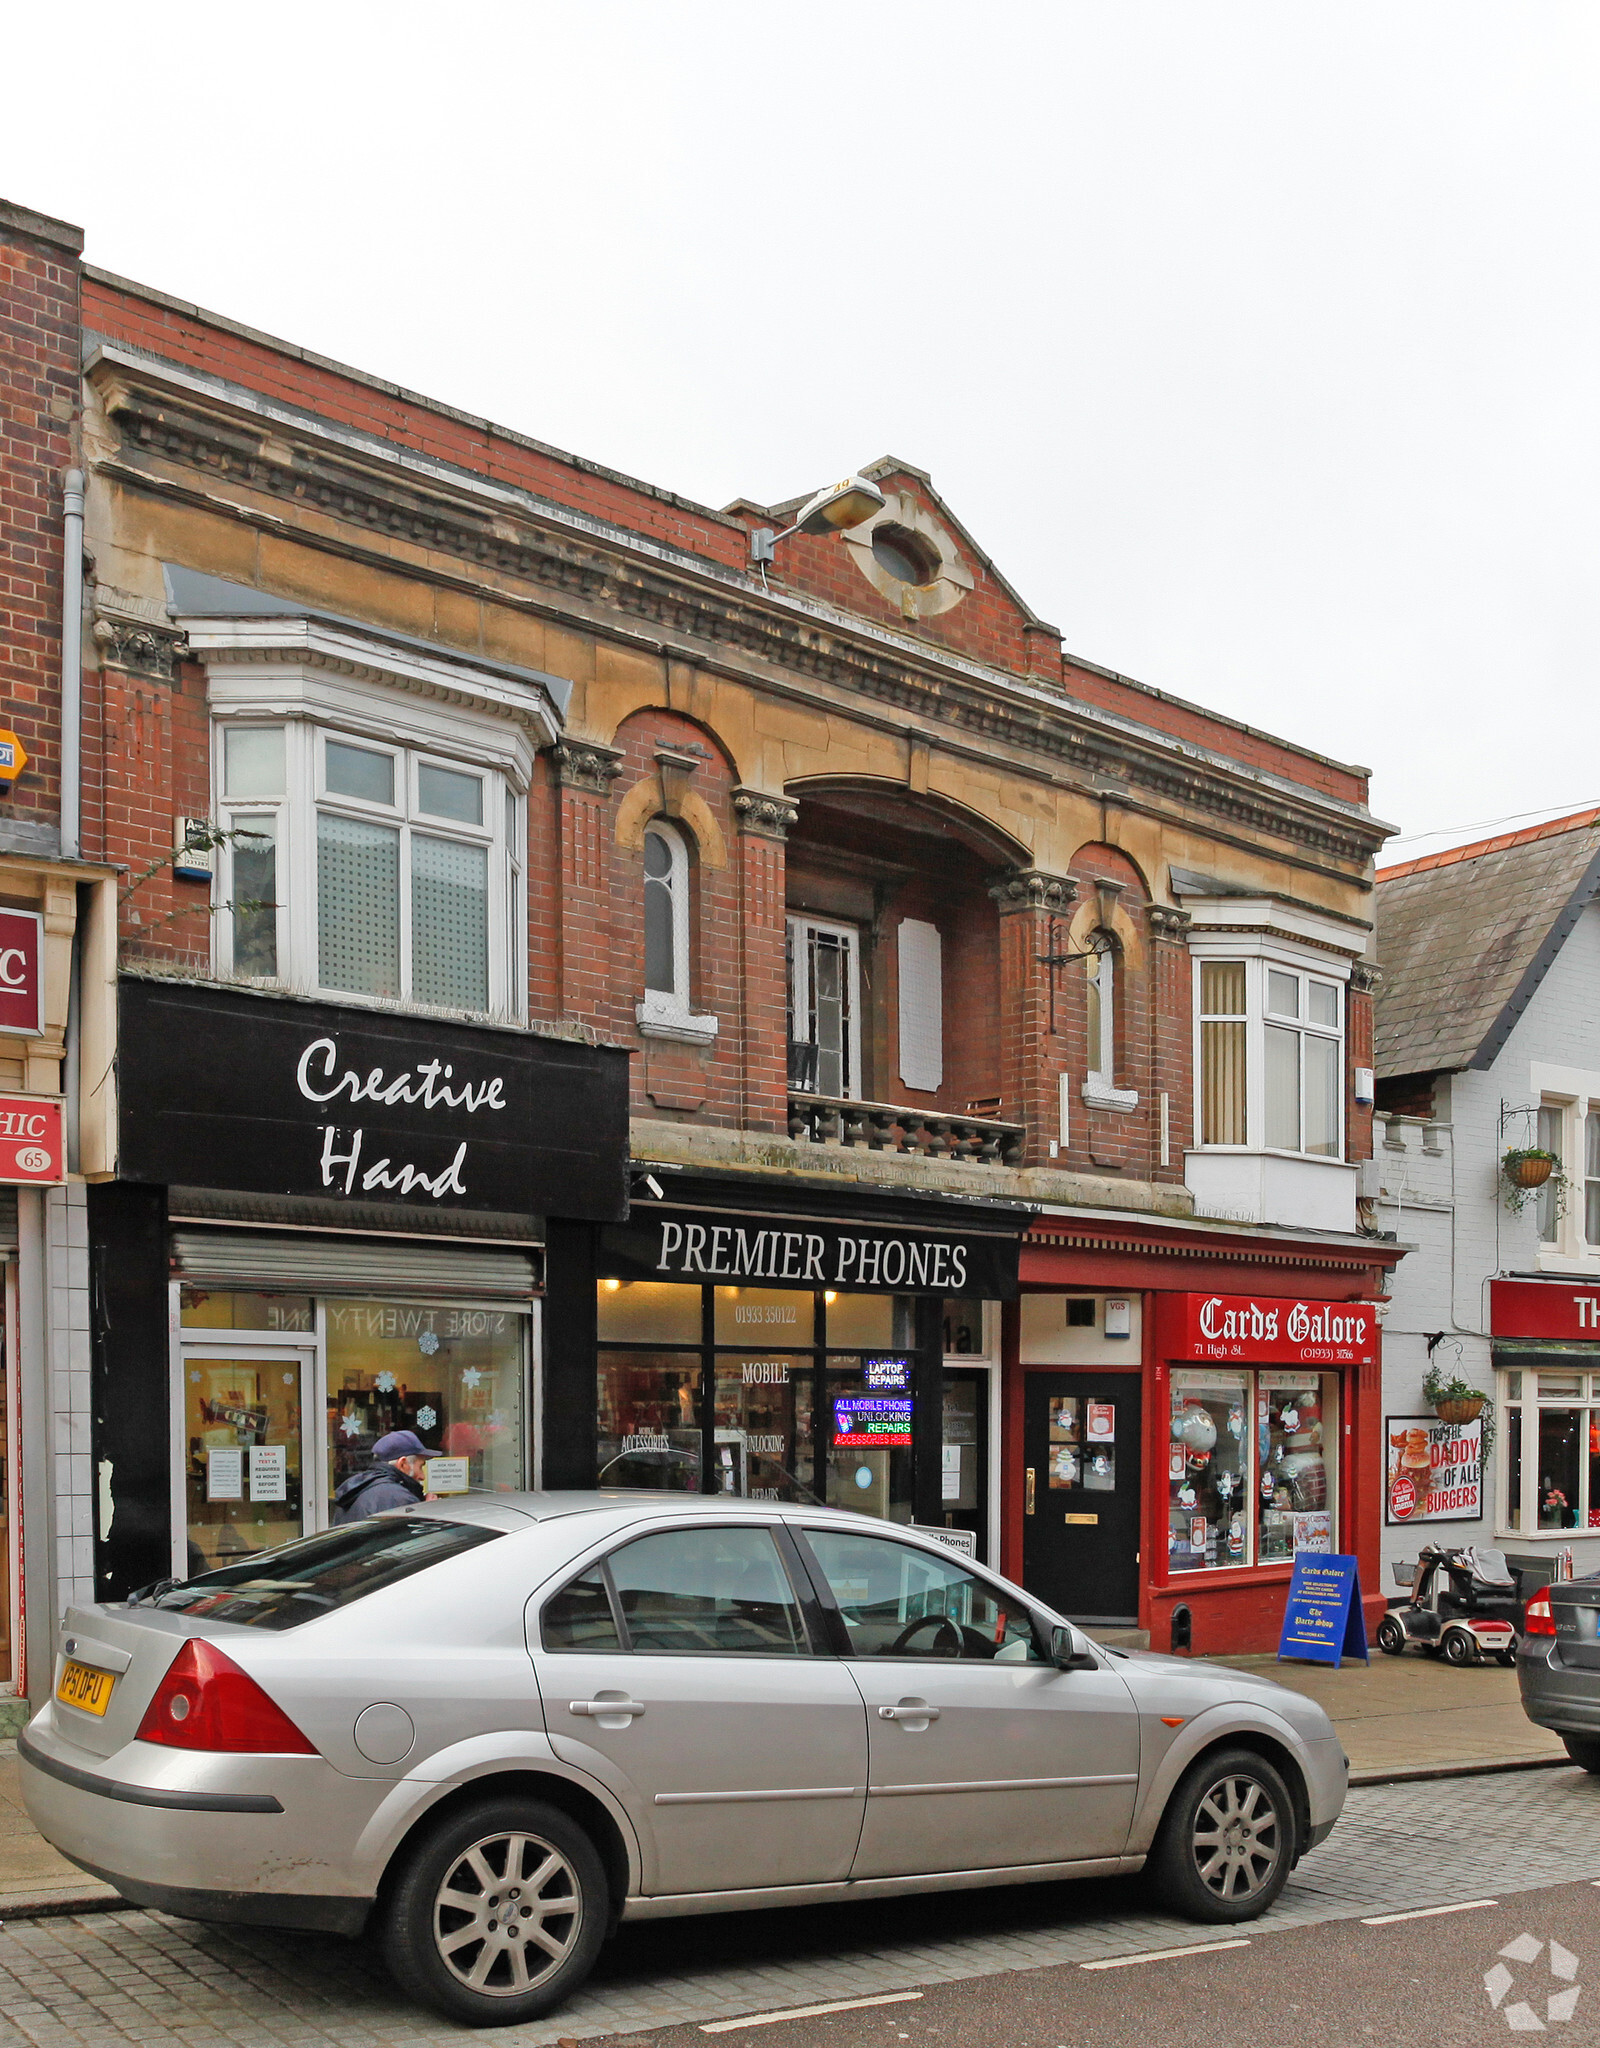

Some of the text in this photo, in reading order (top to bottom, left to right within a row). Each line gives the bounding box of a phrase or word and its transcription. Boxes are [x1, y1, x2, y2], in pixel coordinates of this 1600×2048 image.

[0, 948, 26, 985] C
[297, 1037, 506, 1113] Creative
[24, 1151, 43, 1167] 65
[320, 1126, 467, 1198] Hand
[656, 1221, 967, 1289] PREMIER PHONES
[1110, 1302, 1126, 1310] VGS
[735, 1306, 763, 1324] 01933
[1199, 1297, 1367, 1345] Cards Galore
[1194, 1344, 1203, 1354] 71
[1207, 1344, 1227, 1359] High
[1300, 1348, 1334, 1361] (01933)
[742, 1362, 789, 1384] MOBILE
[869, 1364, 903, 1374] LAPTOP
[869, 1375, 906, 1385] REPAIRS
[836, 1400, 912, 1411] ALL MOBILE PHONE
[858, 1411, 911, 1422] UNLOCKING
[868, 1423, 911, 1433] REPAIRS
[621, 1434, 670, 1453] ACCESSORIES
[746, 1435, 785, 1453] UNLOCKING
[835, 1434, 912, 1445] ACCESSORIES HERE
[1431, 1437, 1480, 1468] DADDY
[1444, 1463, 1479, 1488] OF ALL
[1427, 1485, 1477, 1513] BURGERS
[940, 1535, 970, 1548] Phones
[1301, 1566, 1344, 1577] Cards Galore
